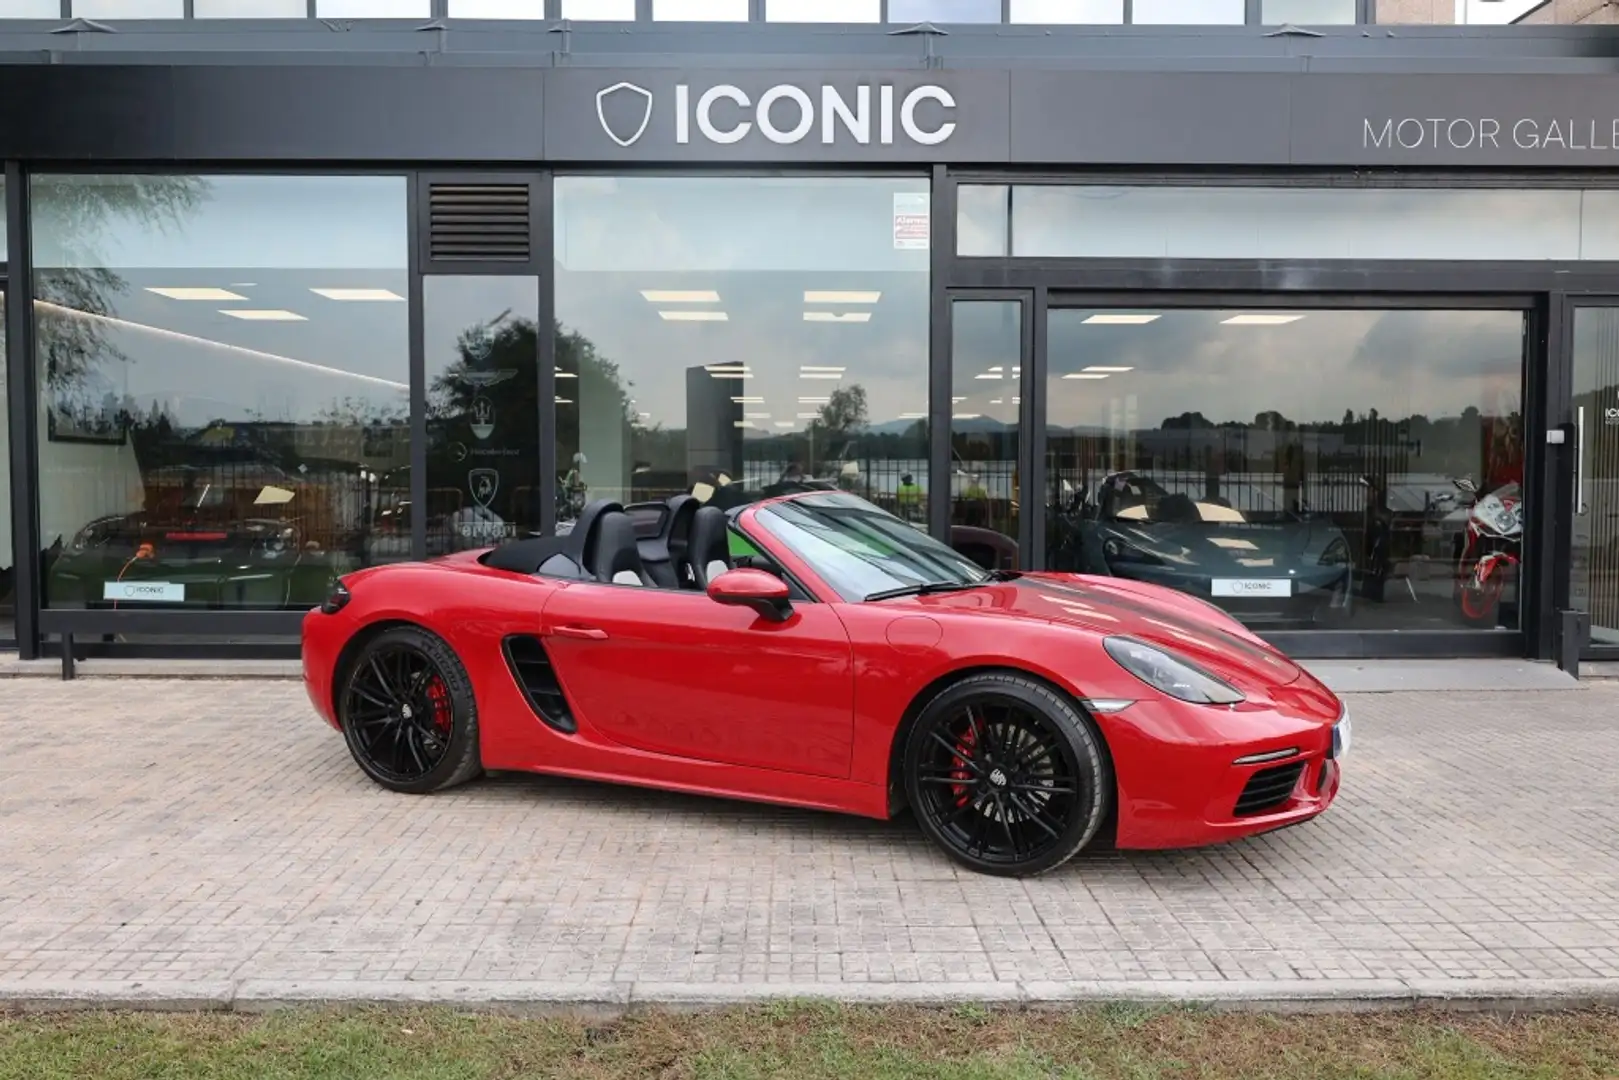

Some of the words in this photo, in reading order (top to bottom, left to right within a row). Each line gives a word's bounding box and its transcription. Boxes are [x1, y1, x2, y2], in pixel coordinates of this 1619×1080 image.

[675, 83, 957, 145] ICONIC
[1363, 118, 1500, 149] MOTOR
[1605, 408, 1619, 418] IC
